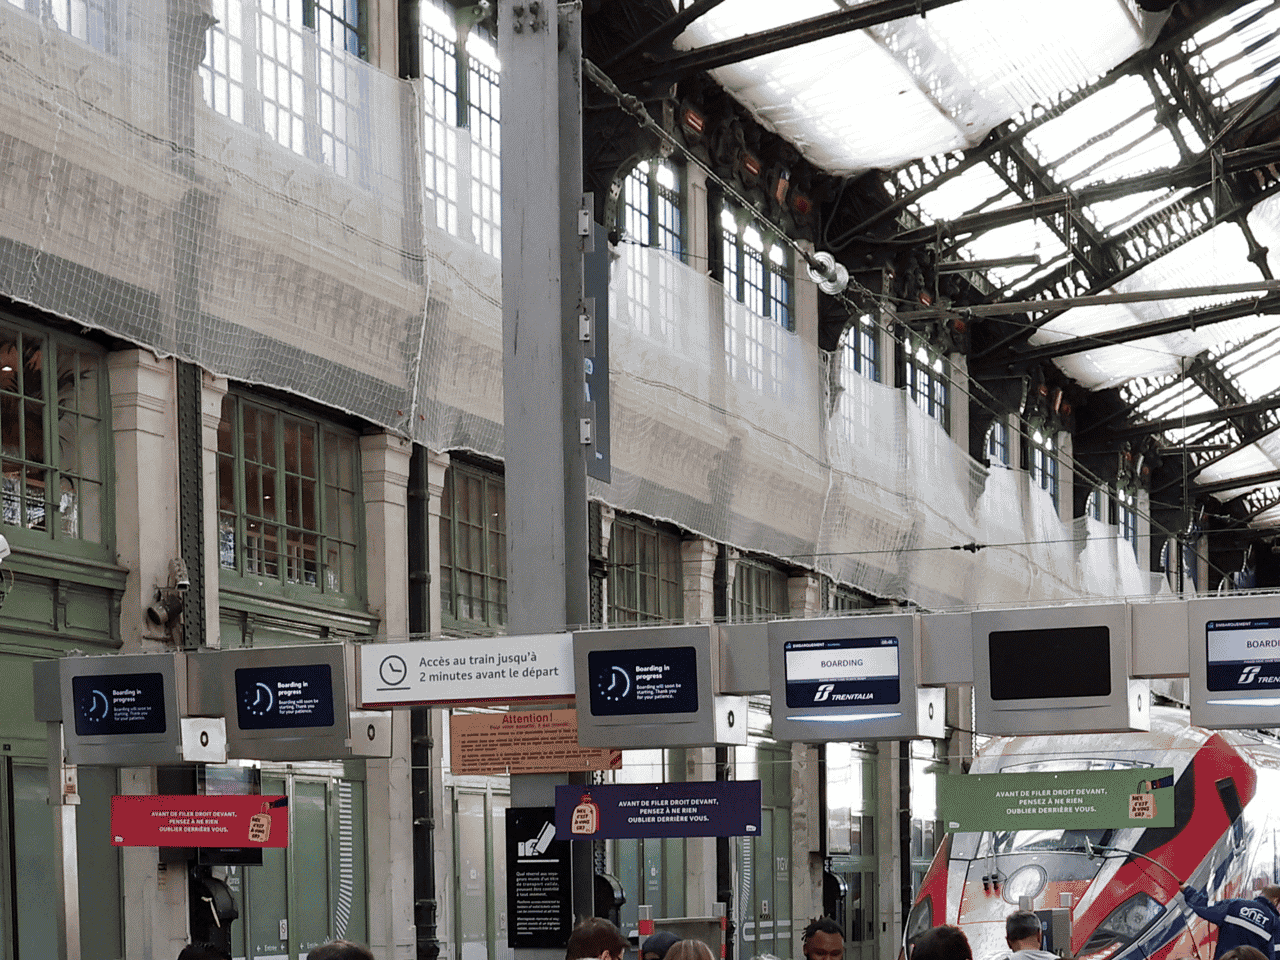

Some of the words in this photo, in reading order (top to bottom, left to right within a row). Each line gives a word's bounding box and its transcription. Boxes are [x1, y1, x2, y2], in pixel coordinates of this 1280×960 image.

[419, 656, 450, 668] Accès
[453, 657, 466, 666] au
[469, 654, 495, 665] train
[821, 659, 863, 668] BOARDING
[636, 665, 663, 673] Boarding
[419, 672, 426, 682] 2
[429, 670, 473, 682] minutes
[475, 668, 506, 680] avant
[509, 667, 519, 678] le
[522, 666, 559, 680] départ
[636, 673, 662, 681] progress
[112, 689, 135, 697] Boarding
[1047, 797, 1054, 805] À
[665, 806, 670, 814] À
